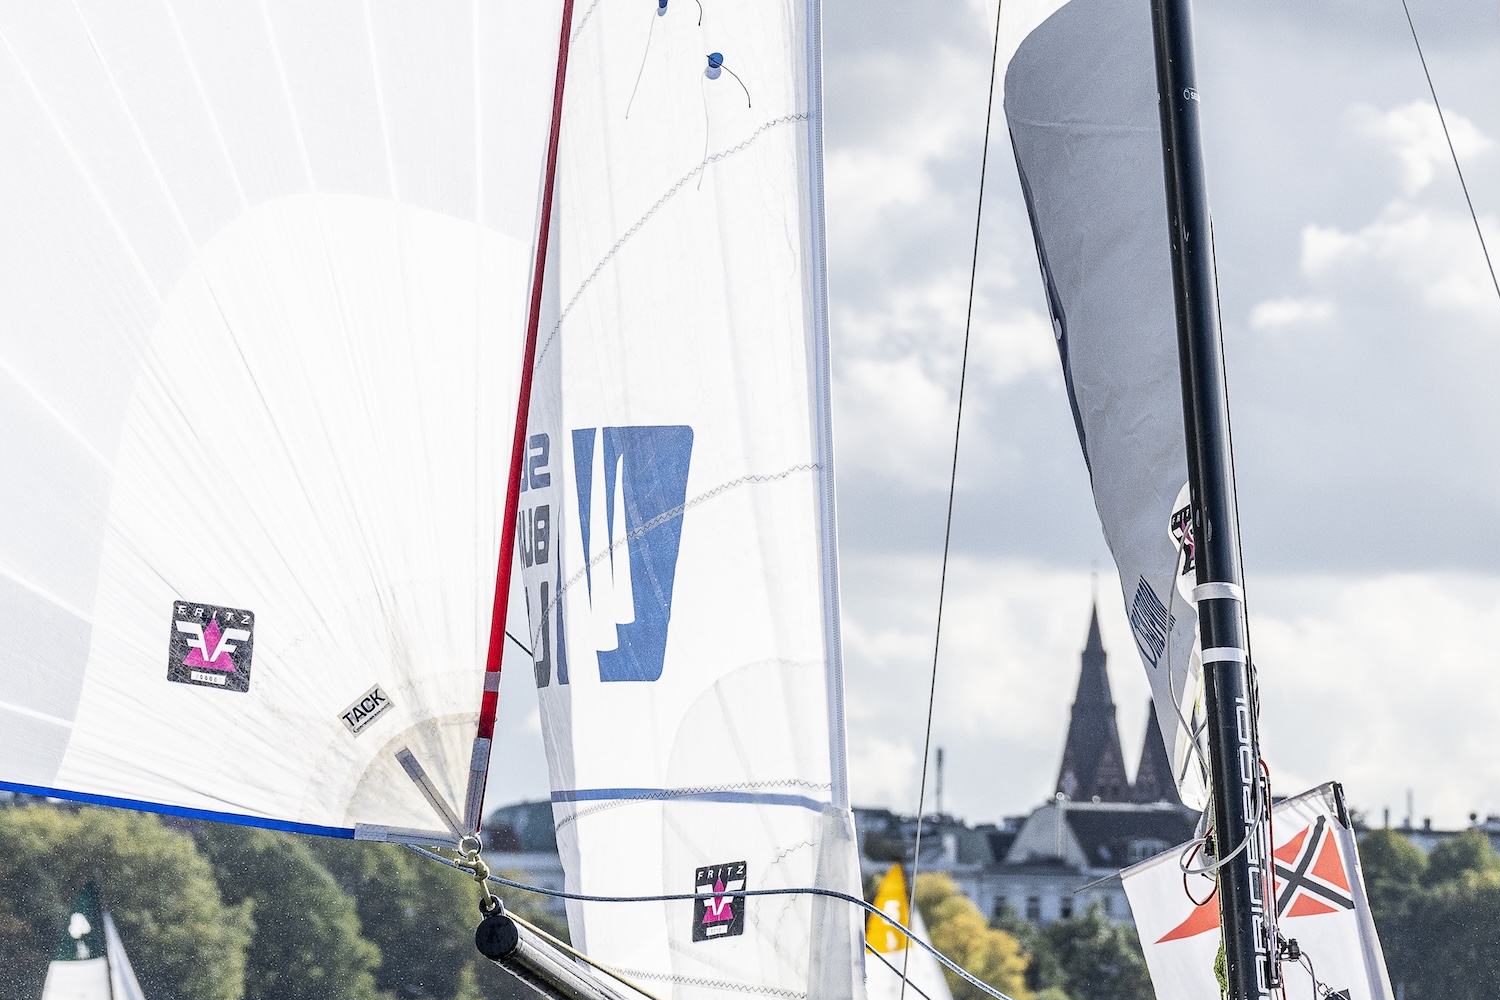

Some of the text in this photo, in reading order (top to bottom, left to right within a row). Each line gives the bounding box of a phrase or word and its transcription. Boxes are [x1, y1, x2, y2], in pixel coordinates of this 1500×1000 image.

[177, 605, 250, 625] FRITZ
[342, 688, 386, 727] TACK
[697, 866, 745, 881] FRITZ
